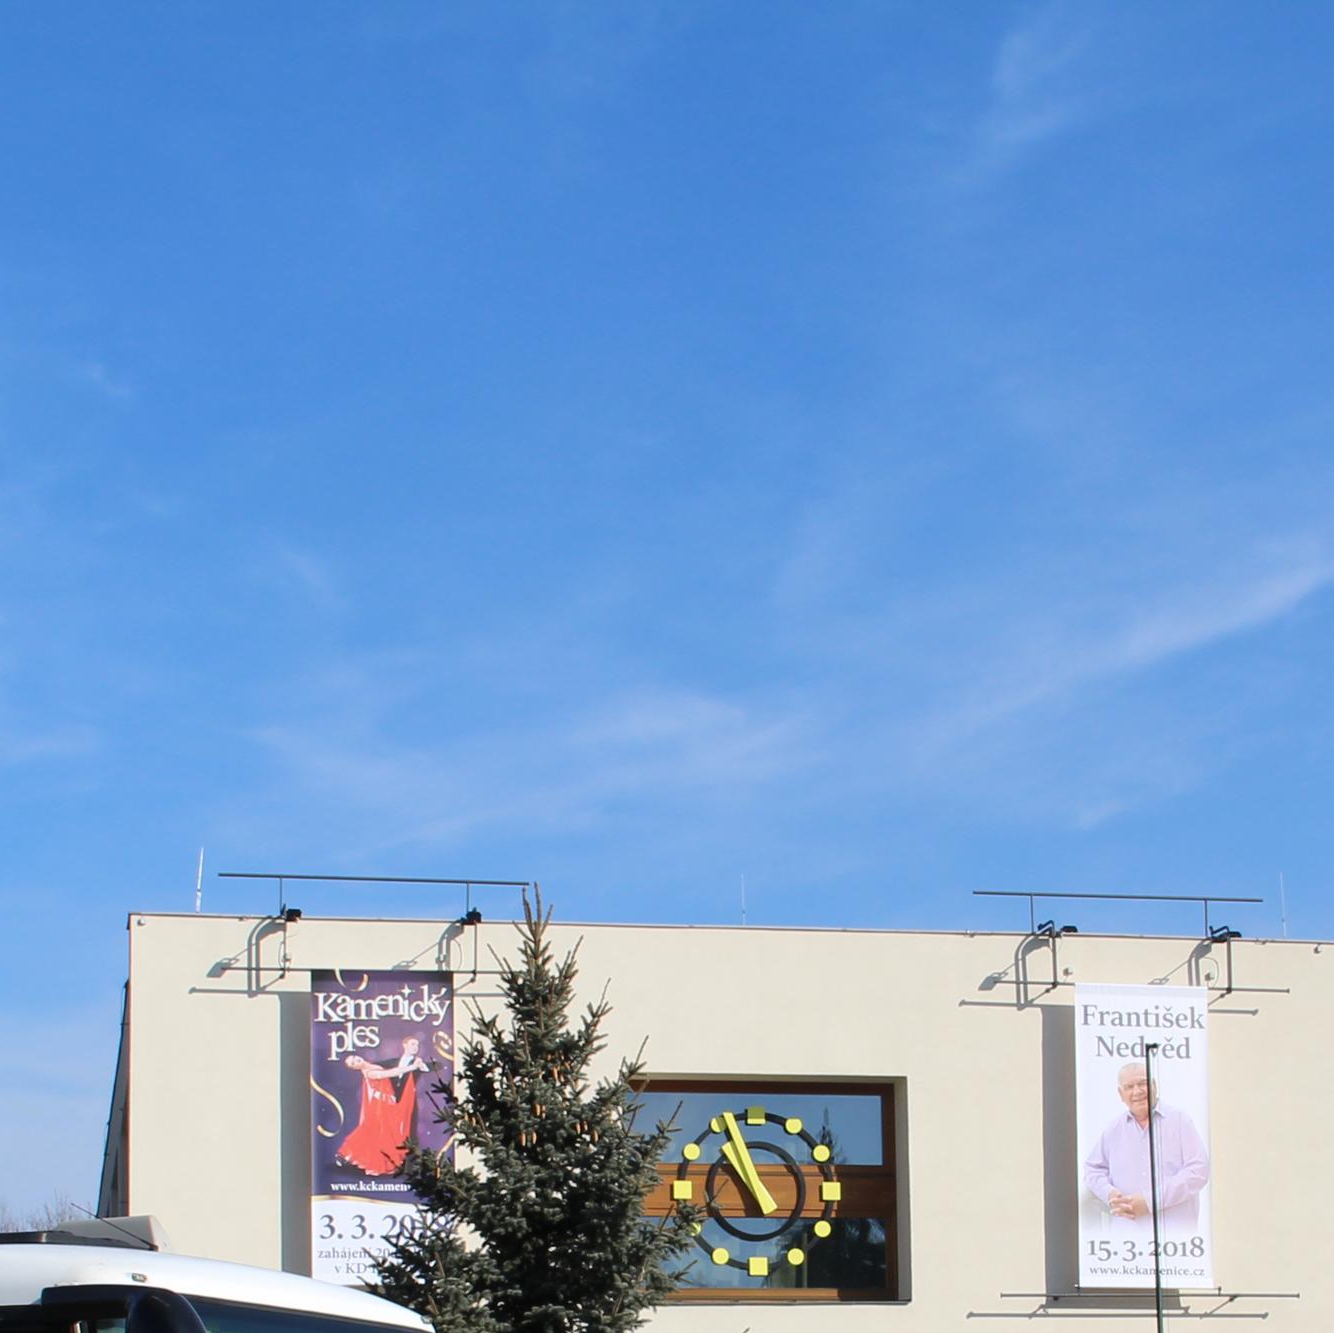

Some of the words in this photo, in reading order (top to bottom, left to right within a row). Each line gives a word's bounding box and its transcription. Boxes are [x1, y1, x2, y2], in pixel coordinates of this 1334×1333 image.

[314, 984, 450, 1026] Kamenický
[1082, 1004, 1205, 1029] František
[327, 1021, 380, 1061] ples
[1095, 1036, 1191, 1059] Nedvěd
